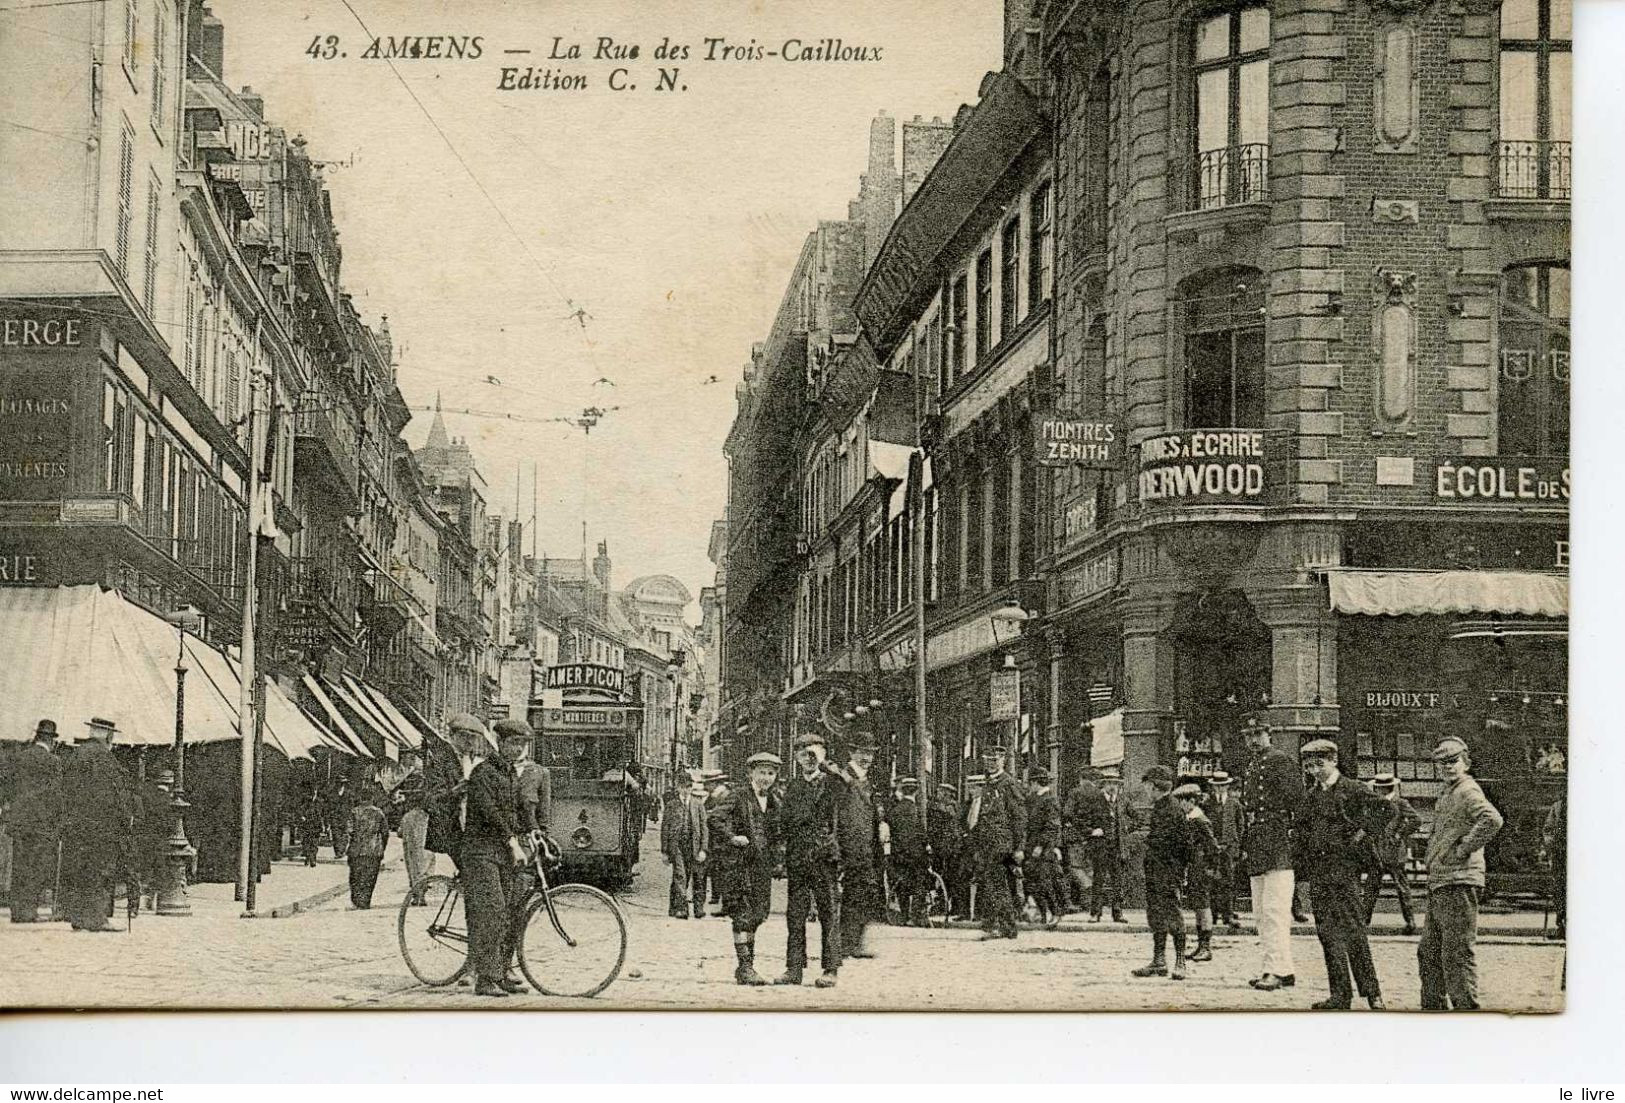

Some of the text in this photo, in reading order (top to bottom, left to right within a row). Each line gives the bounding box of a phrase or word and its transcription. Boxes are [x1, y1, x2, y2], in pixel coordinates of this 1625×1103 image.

[4, 319, 81, 345] ERGE
[1042, 421, 1115, 441] MONTRES
[1048, 442, 1109, 460] ZENITH
[1438, 460, 1536, 498] ÉCOLE
[549, 666, 622, 690] AMER PICON
[1366, 692, 1422, 707] BIJOUX
